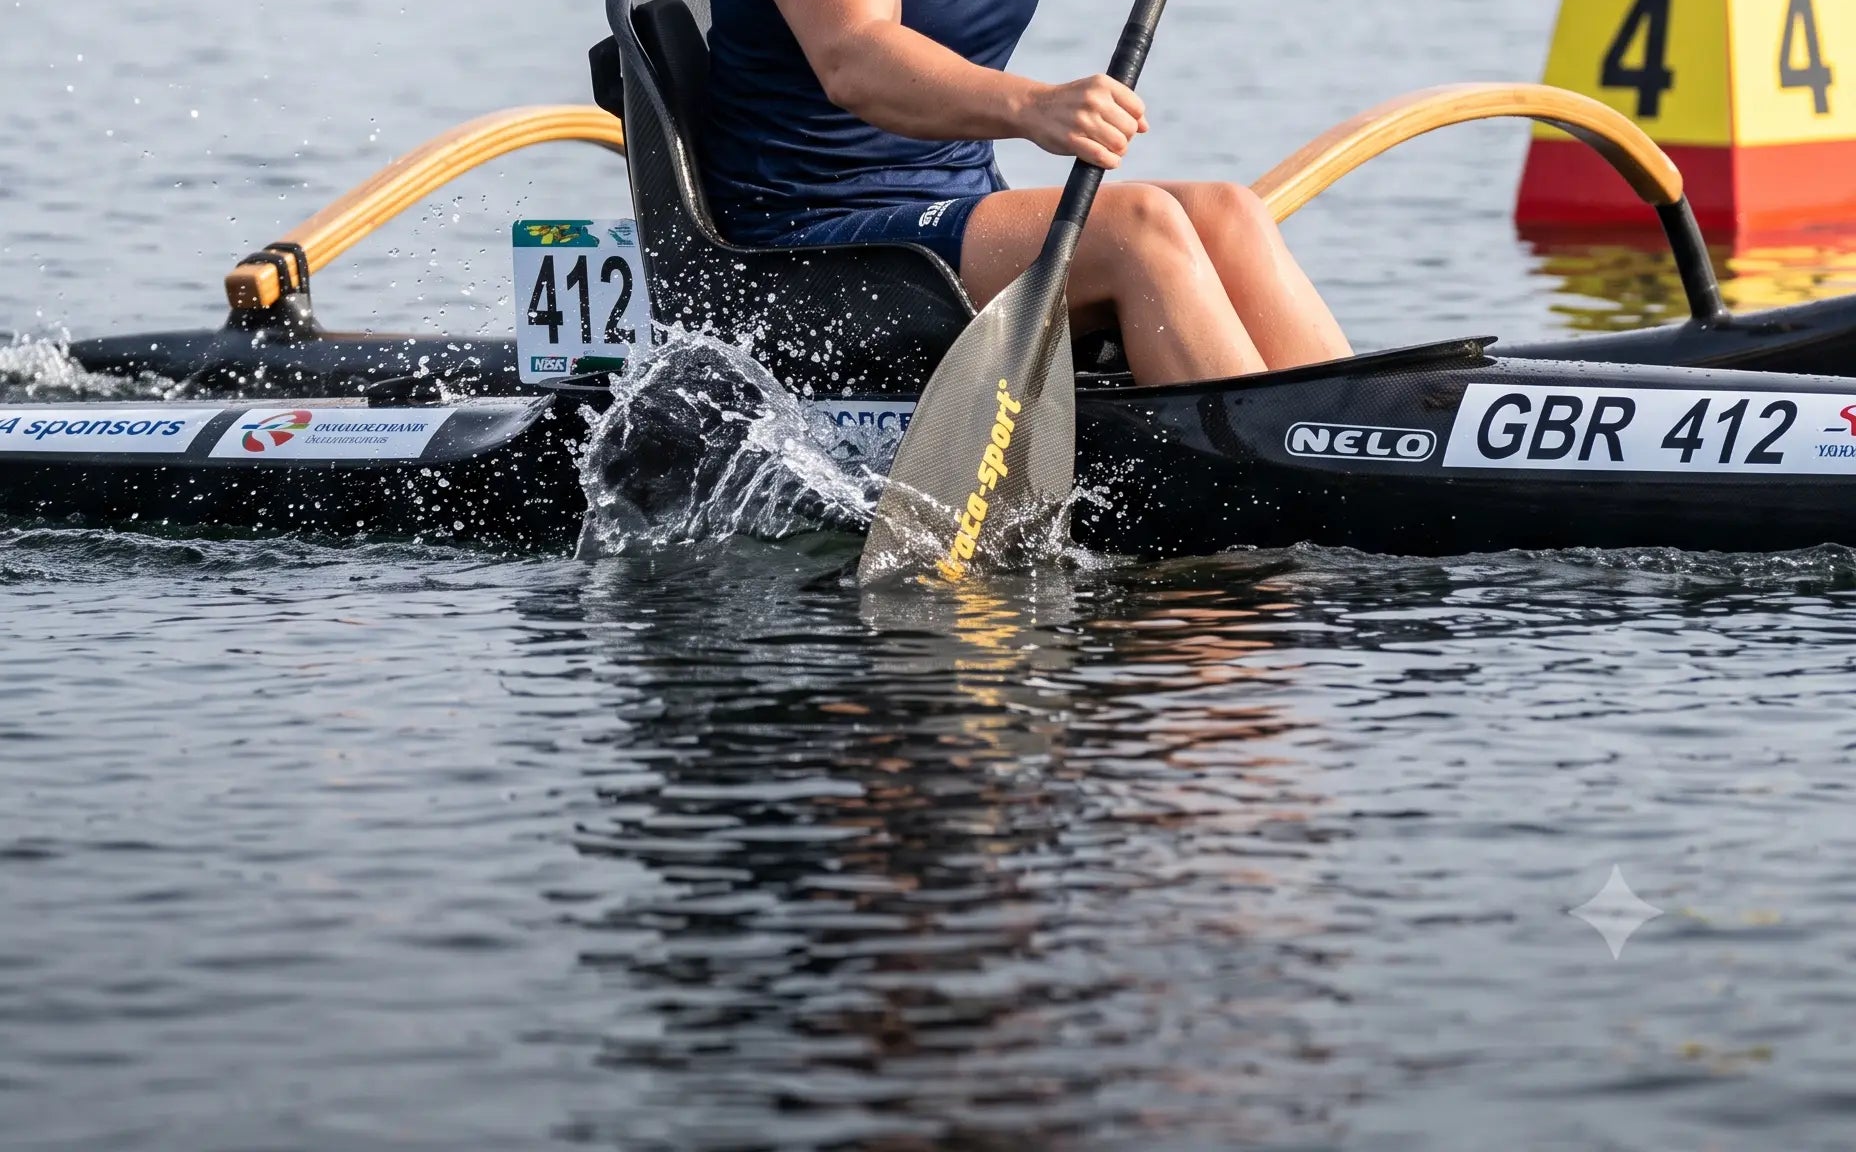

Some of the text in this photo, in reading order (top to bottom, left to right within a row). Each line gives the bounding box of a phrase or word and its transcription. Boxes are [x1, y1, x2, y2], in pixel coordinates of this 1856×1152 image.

[527, 255, 636, 344] 412
[1291, 427, 1430, 457] NELO
[1477, 393, 1798, 465] GBR 412
